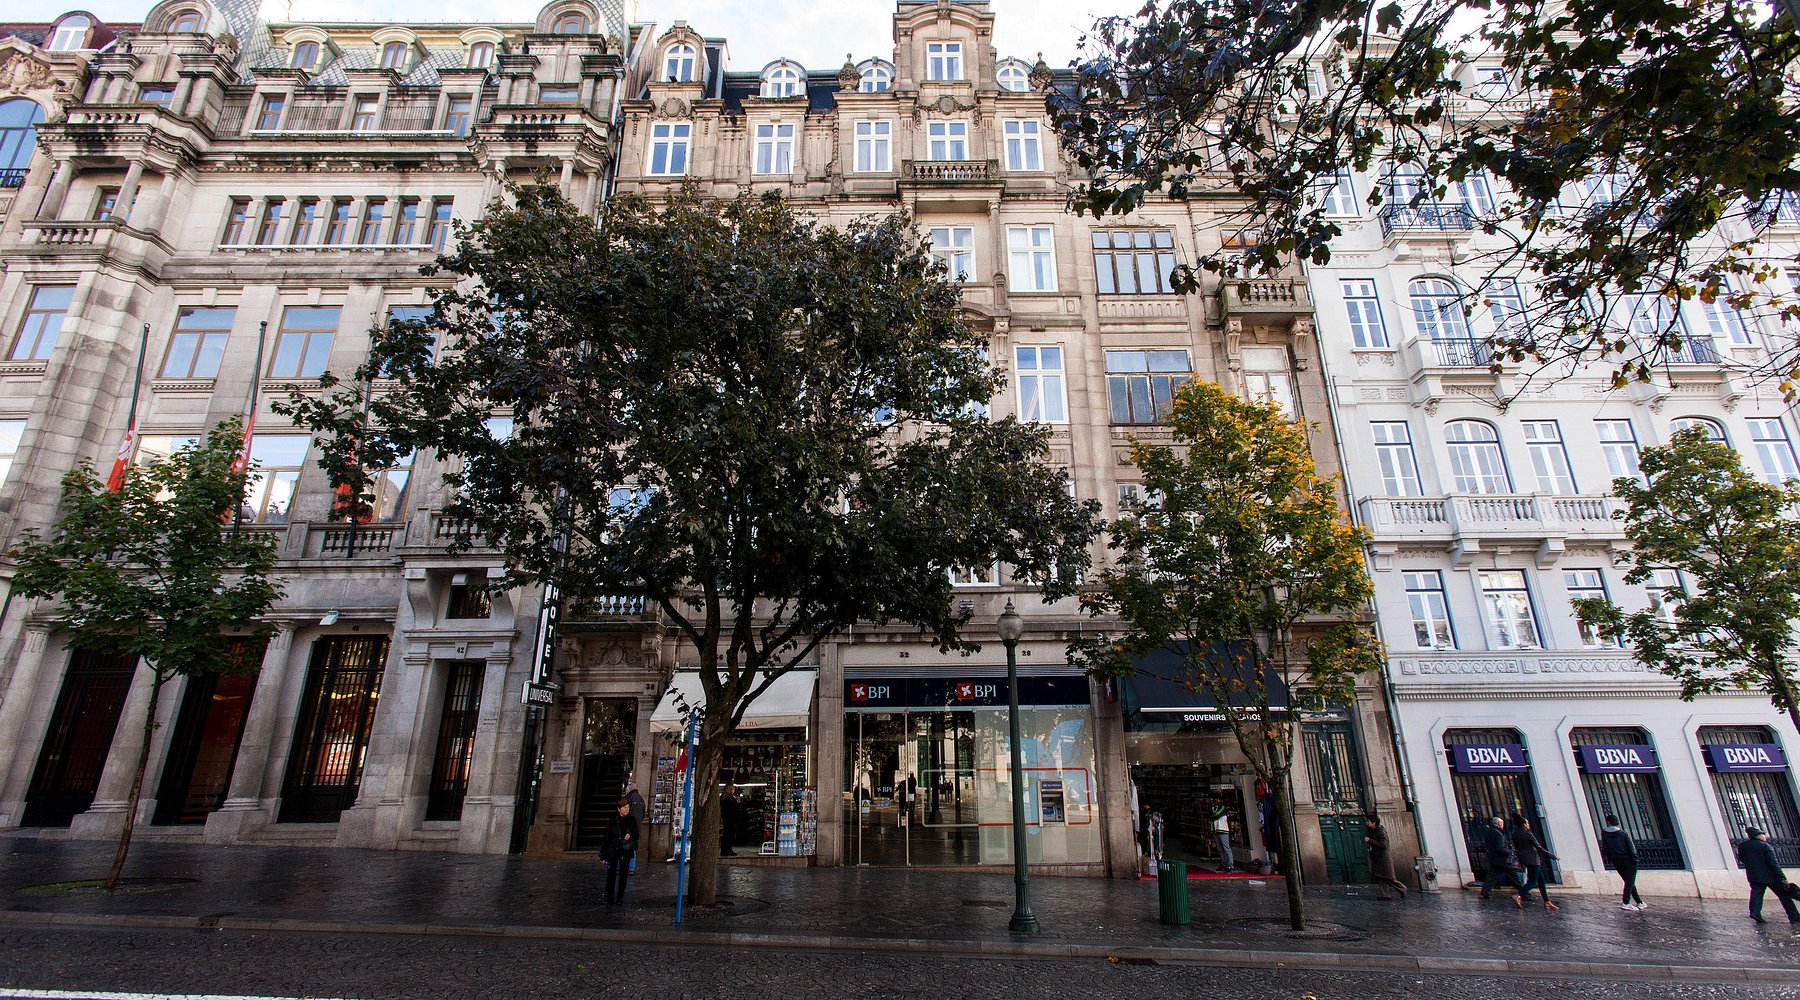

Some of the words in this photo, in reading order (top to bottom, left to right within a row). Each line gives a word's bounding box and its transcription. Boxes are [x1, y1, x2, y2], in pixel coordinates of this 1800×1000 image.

[541, 586, 559, 678] HOTEL
[457, 646, 465, 654] 42
[529, 687, 553, 704] UNIVERSAL
[868, 686, 890, 699] BPI
[974, 685, 997, 698] BPI
[1184, 714, 1227, 722] SOUVENIRS
[1466, 747, 1514, 764] BBVA
[1594, 748, 1643, 765] BBVA
[1723, 747, 1772, 764] BBVA
